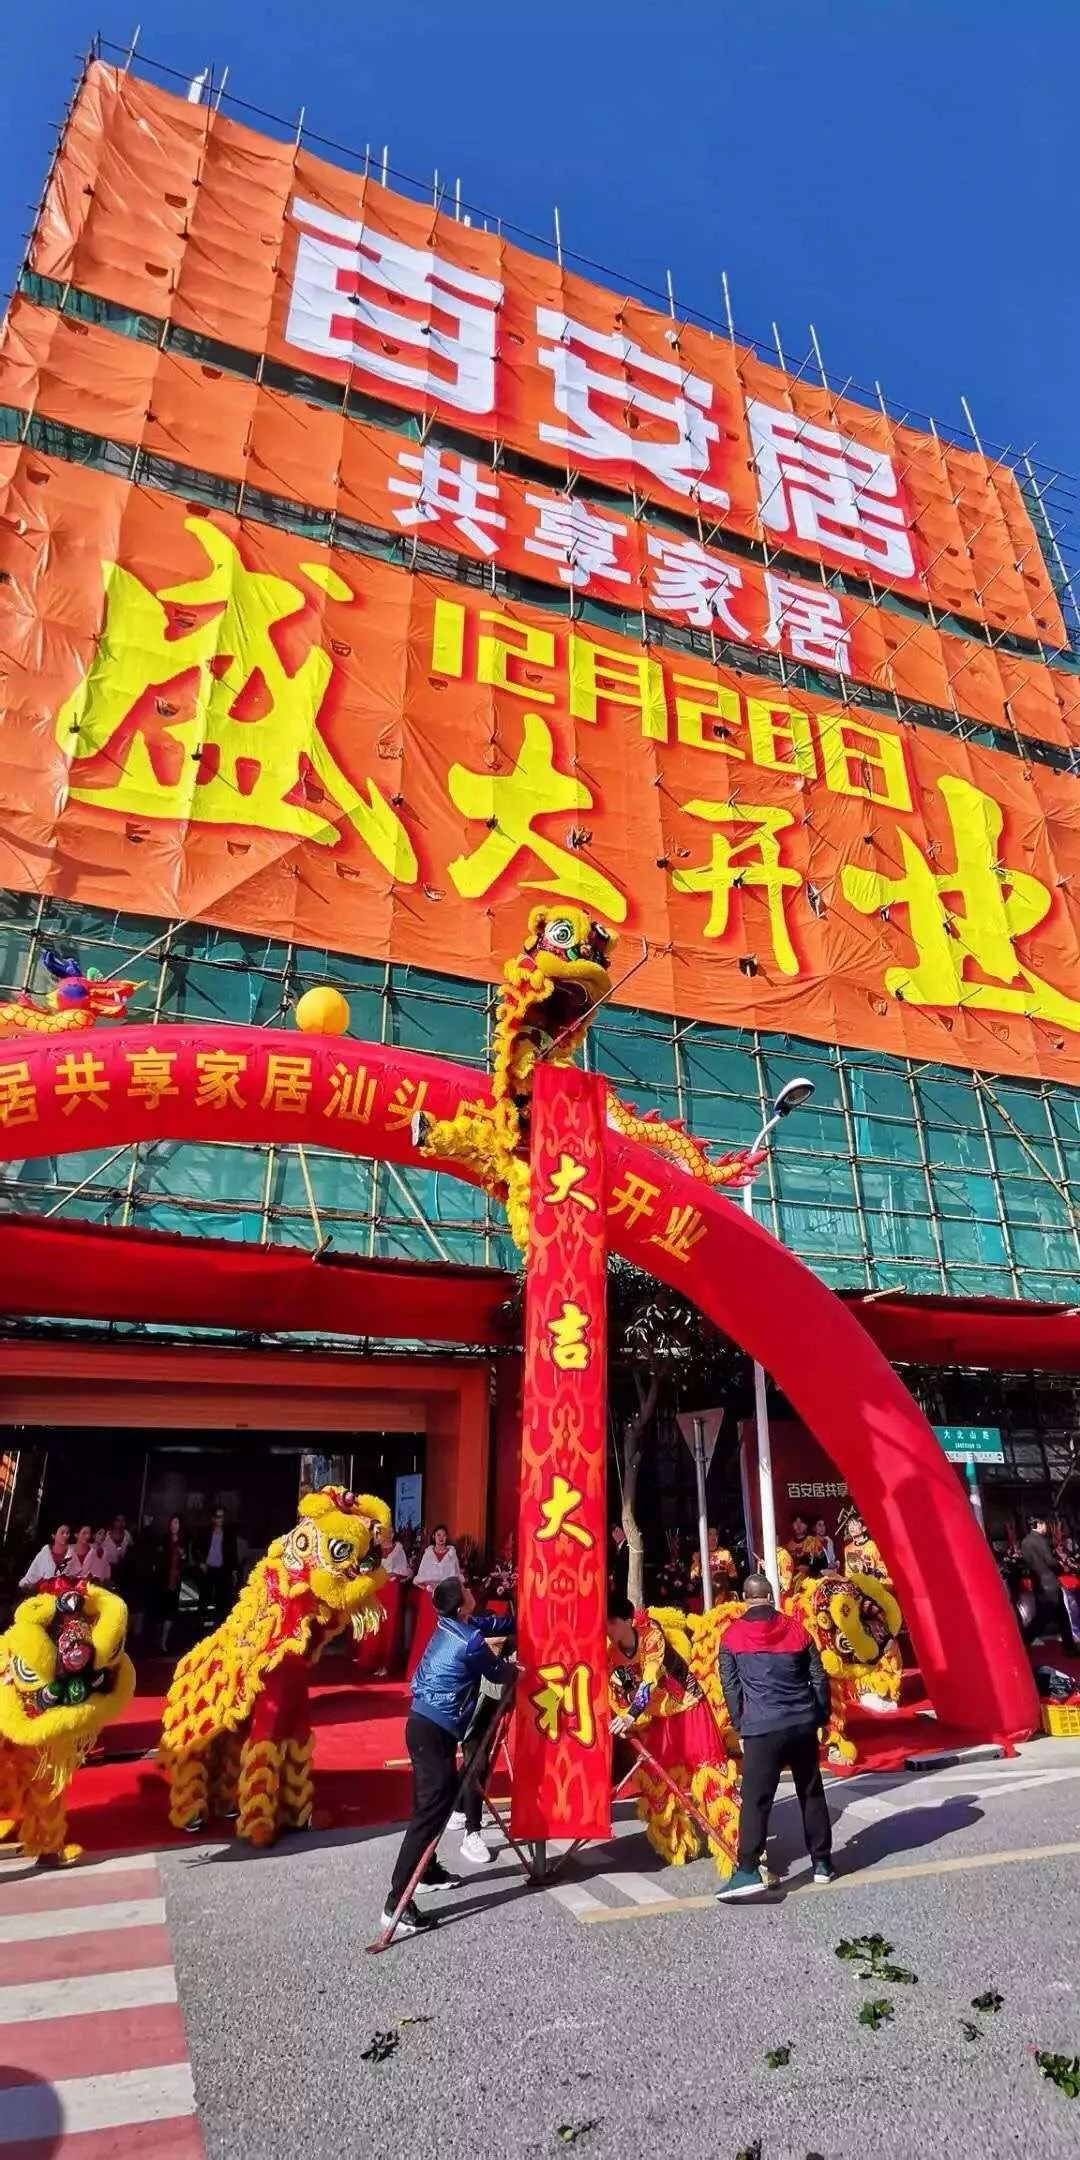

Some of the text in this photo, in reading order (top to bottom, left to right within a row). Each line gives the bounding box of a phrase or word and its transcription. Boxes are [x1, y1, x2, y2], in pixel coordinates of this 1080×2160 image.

[285, 196, 918, 582] 百安居
[388, 448, 854, 677] 共享家居
[57, 518, 1080, 1031] 盛大开业
[431, 597, 914, 813] 12月28日
[533, 1155, 597, 1747] 大吉大利
